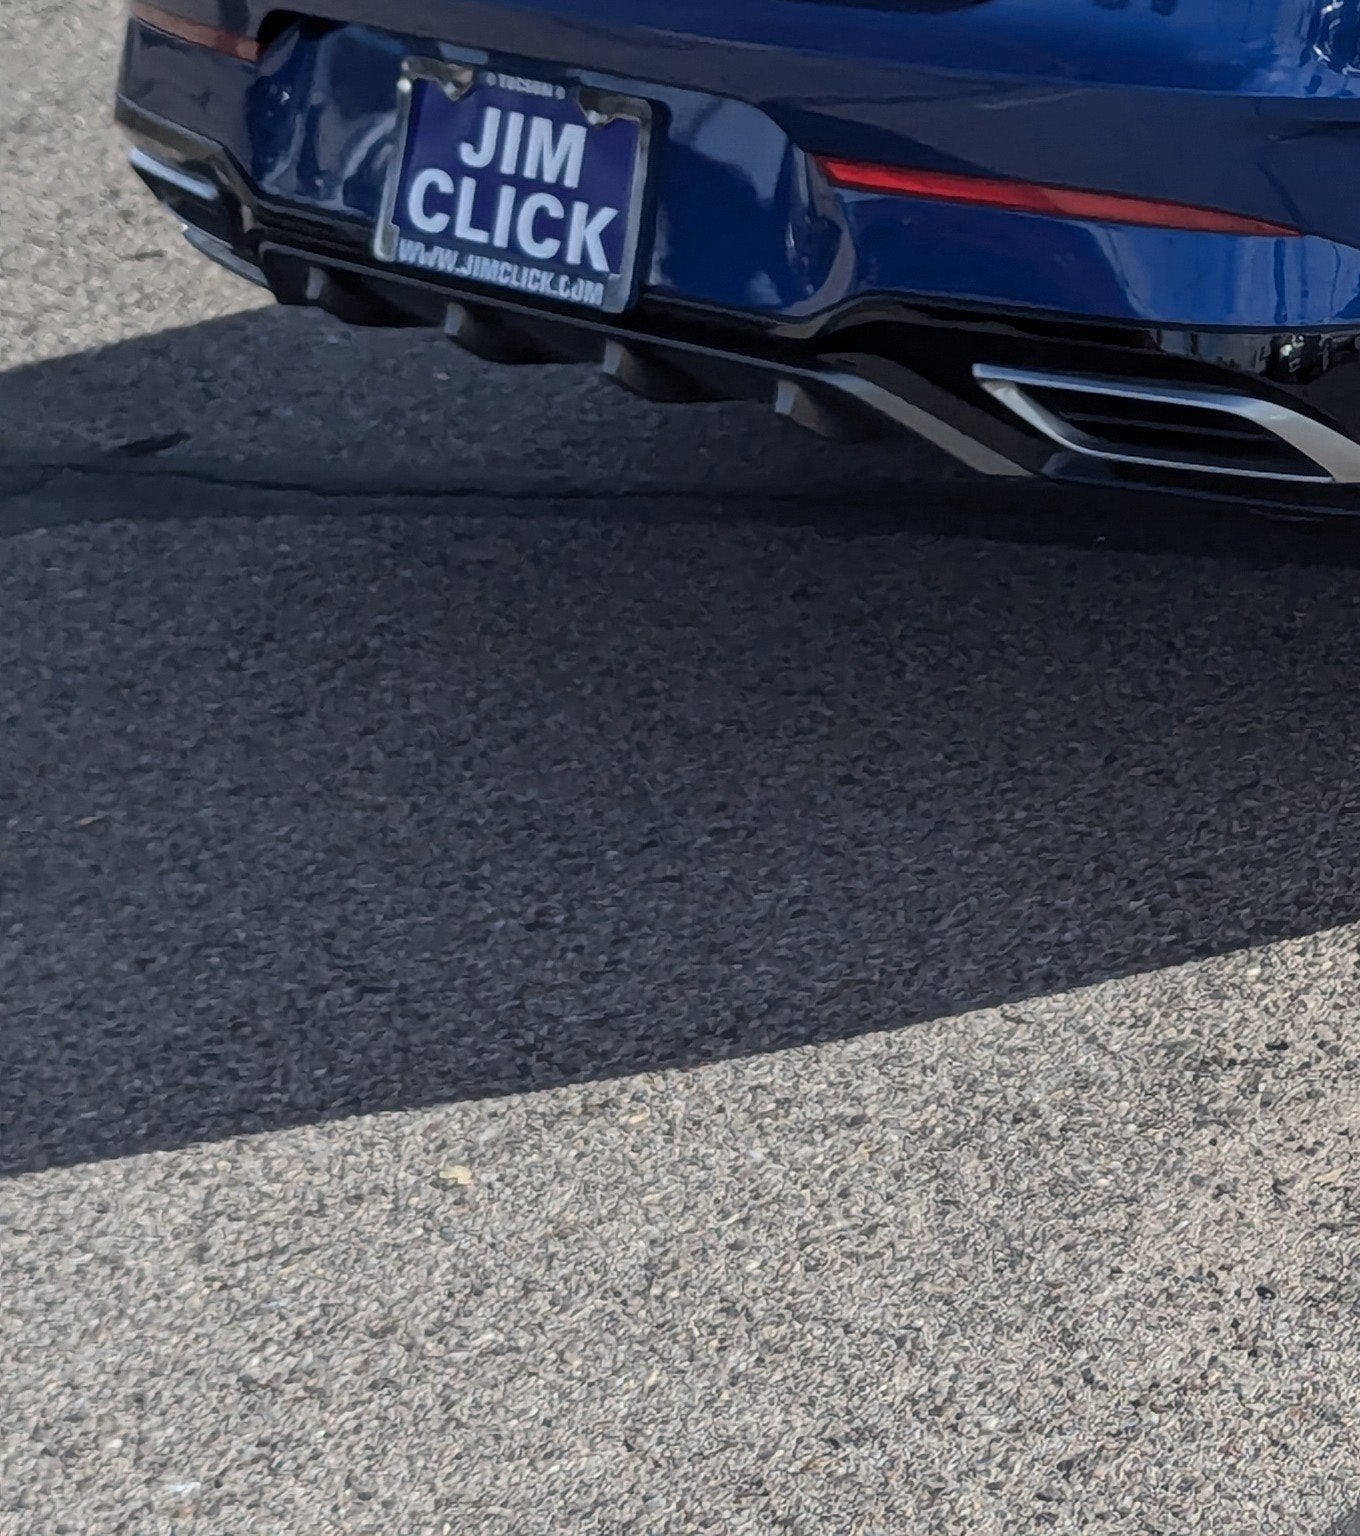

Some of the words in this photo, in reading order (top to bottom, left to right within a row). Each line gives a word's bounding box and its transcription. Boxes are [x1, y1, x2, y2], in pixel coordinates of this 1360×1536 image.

[458, 106, 588, 188] JIM
[408, 167, 620, 273] CLICK
[397, 237, 605, 307] WWW.JIMCLICK.COM
